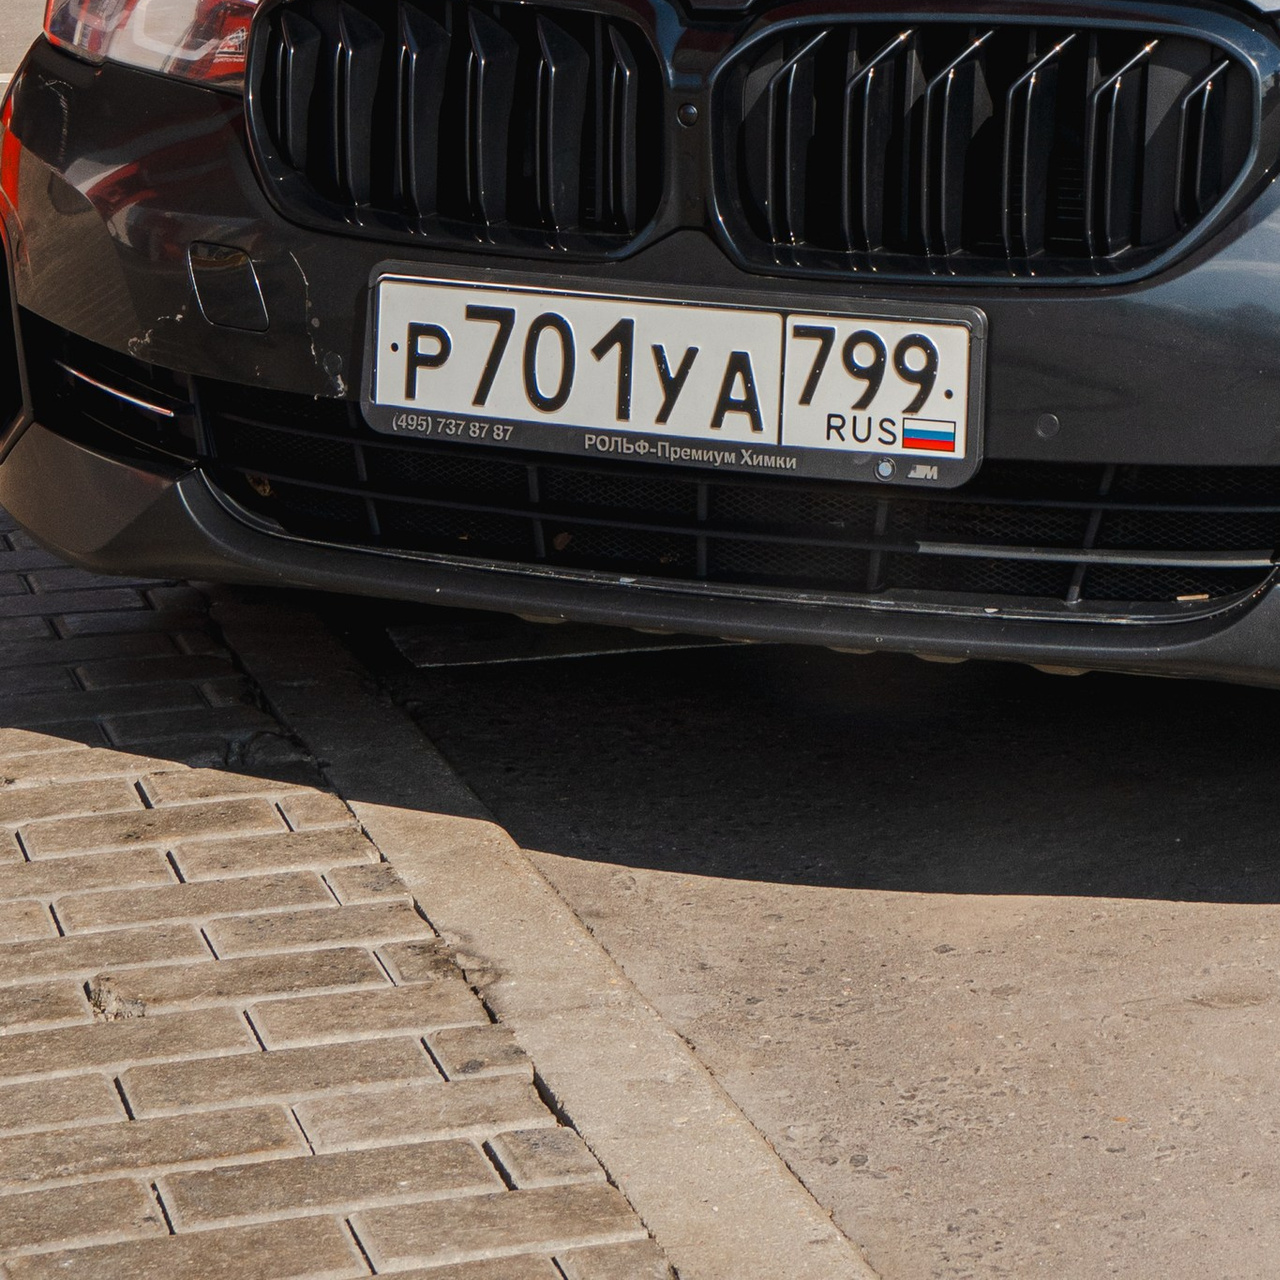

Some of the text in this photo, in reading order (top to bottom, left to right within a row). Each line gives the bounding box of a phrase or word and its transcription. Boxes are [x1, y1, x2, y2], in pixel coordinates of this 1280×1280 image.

[793, 324, 939, 415] 799
[392, 412, 514, 441] (495) 737 87 87
[826, 413, 897, 446] RUS
[584, 433, 797, 470] РОЛЬФ-Премиум Химки
